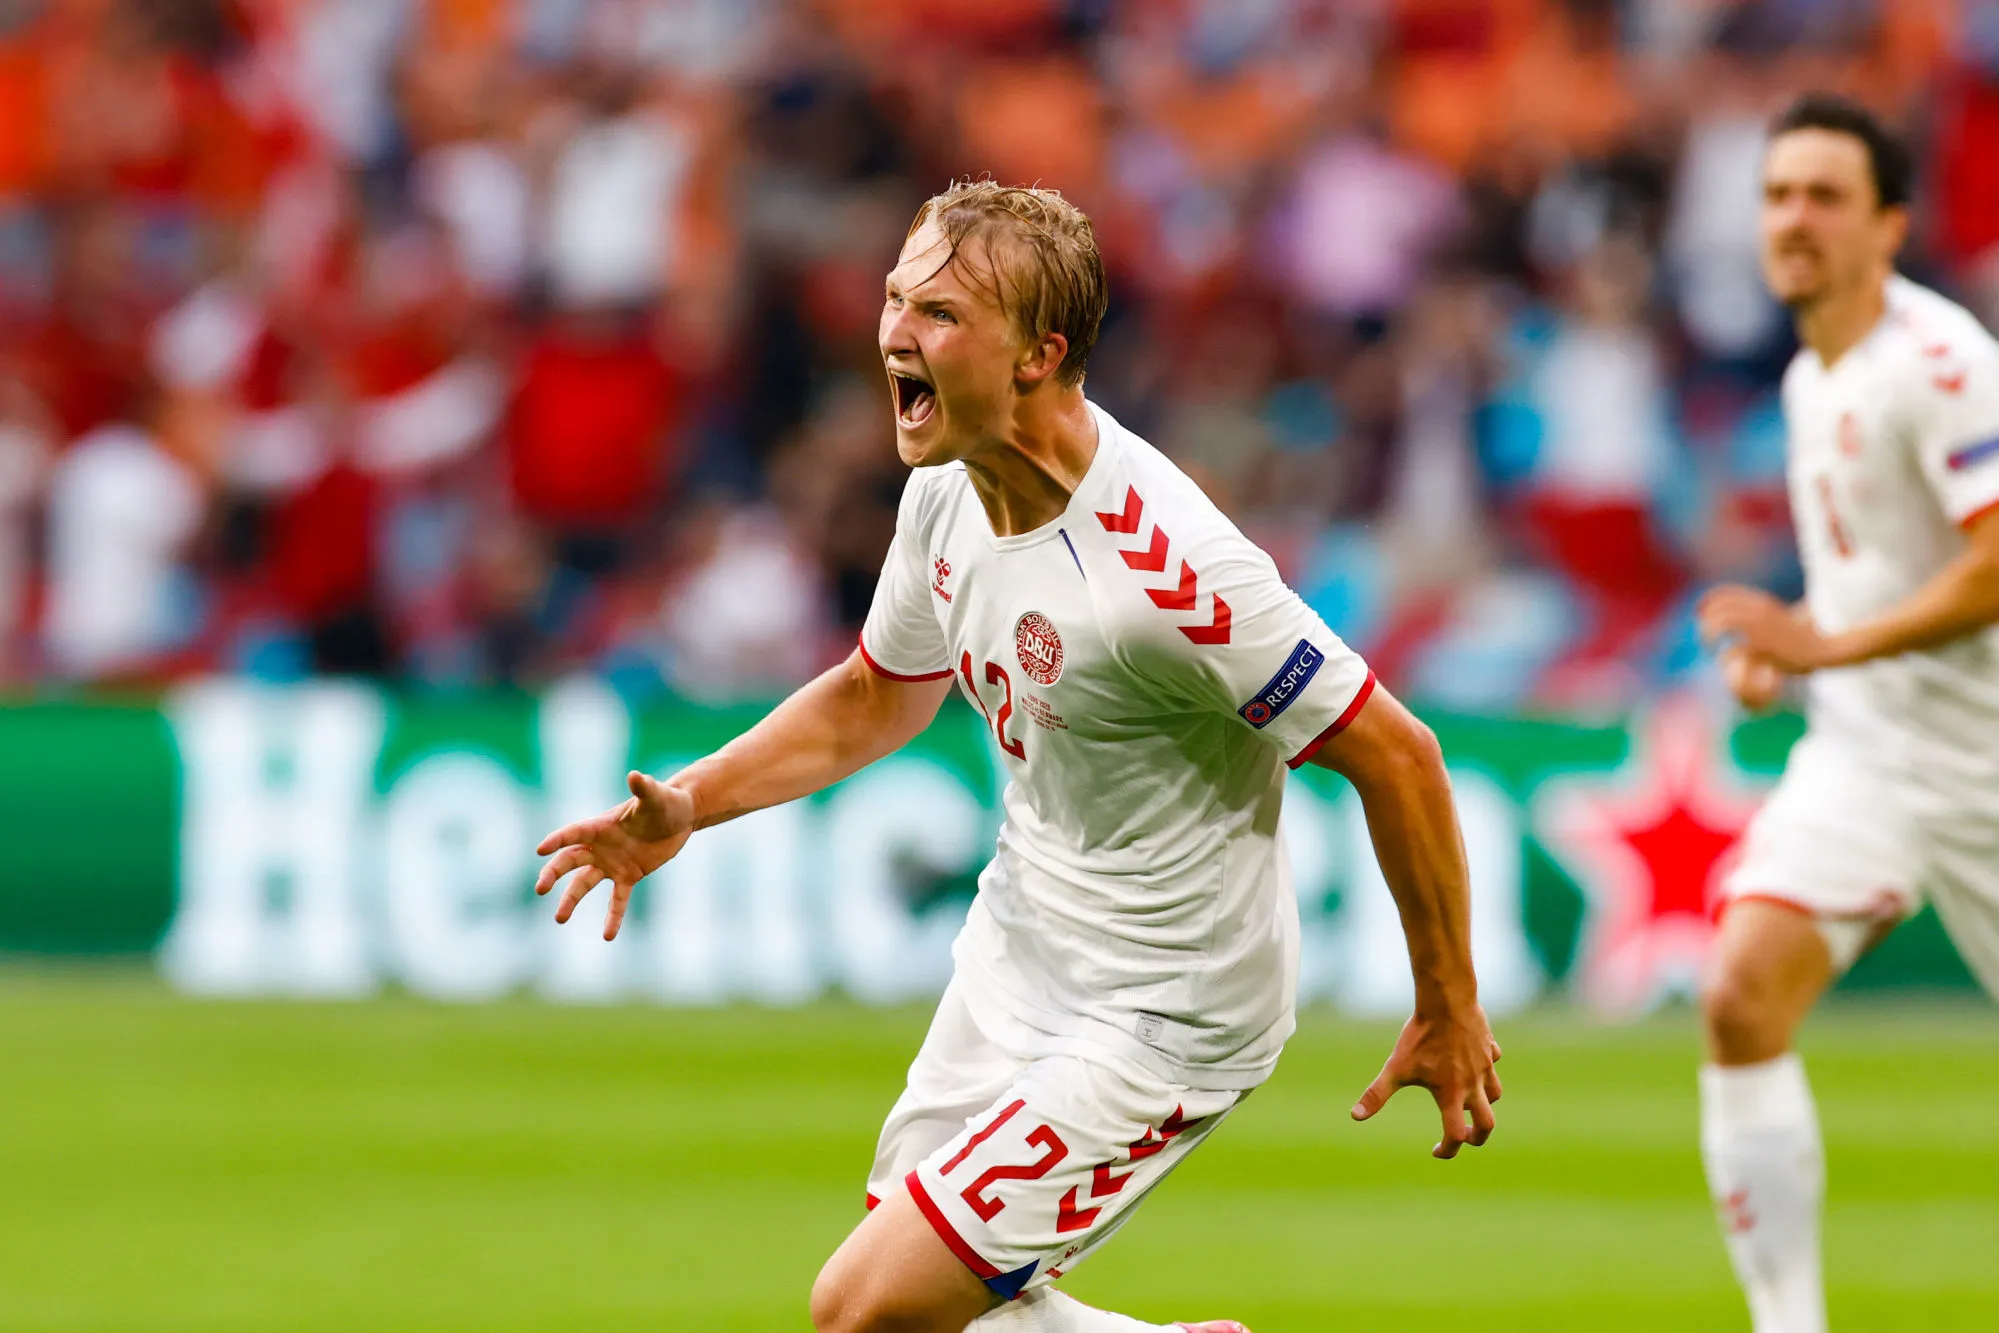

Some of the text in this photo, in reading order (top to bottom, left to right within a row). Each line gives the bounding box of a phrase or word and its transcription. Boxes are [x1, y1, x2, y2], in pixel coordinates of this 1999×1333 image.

[1025, 631, 1055, 665] DBU
[1026, 667, 1047, 684] 1889
[1266, 645, 1317, 707] RESPECT
[960, 650, 1027, 762] 12
[938, 1098, 1069, 1224] 12
